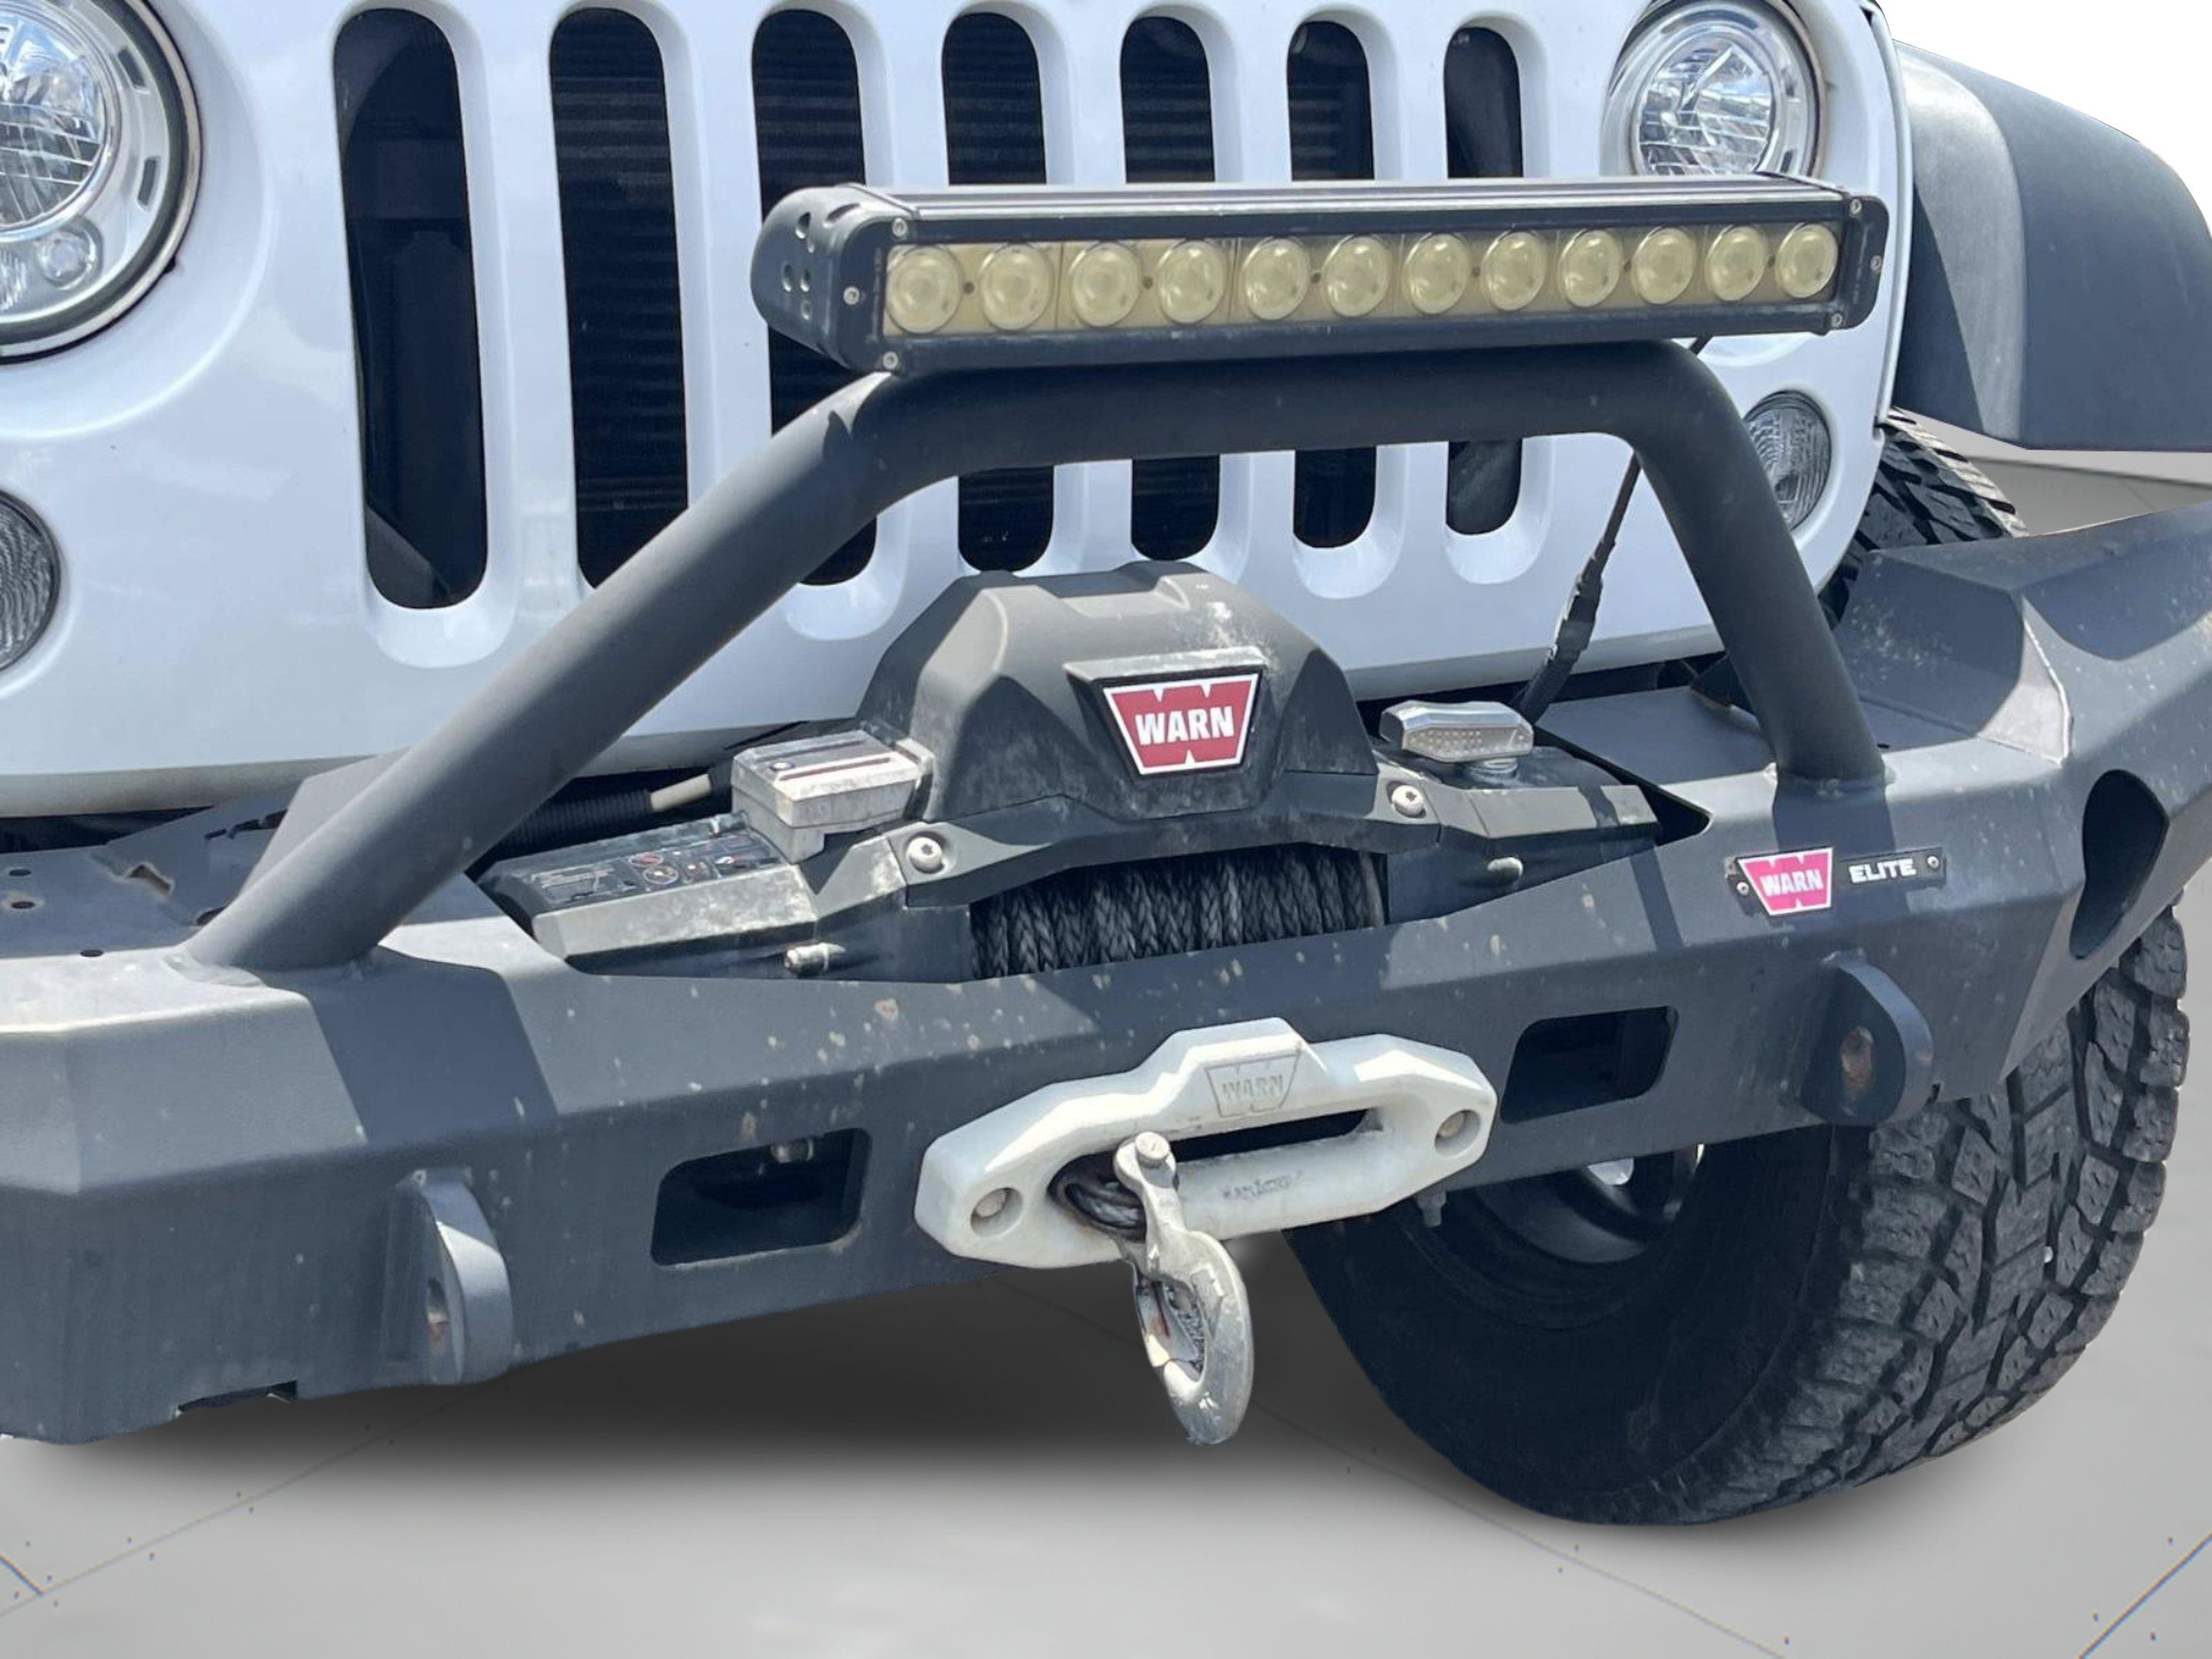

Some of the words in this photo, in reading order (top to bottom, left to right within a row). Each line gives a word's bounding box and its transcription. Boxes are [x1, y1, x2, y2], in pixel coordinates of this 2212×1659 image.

[1134, 706, 1234, 746] WARN
[1760, 868, 1823, 896] WARN
[1848, 858, 1916, 883] ELITE
[1222, 1074, 1283, 1104] WARN
